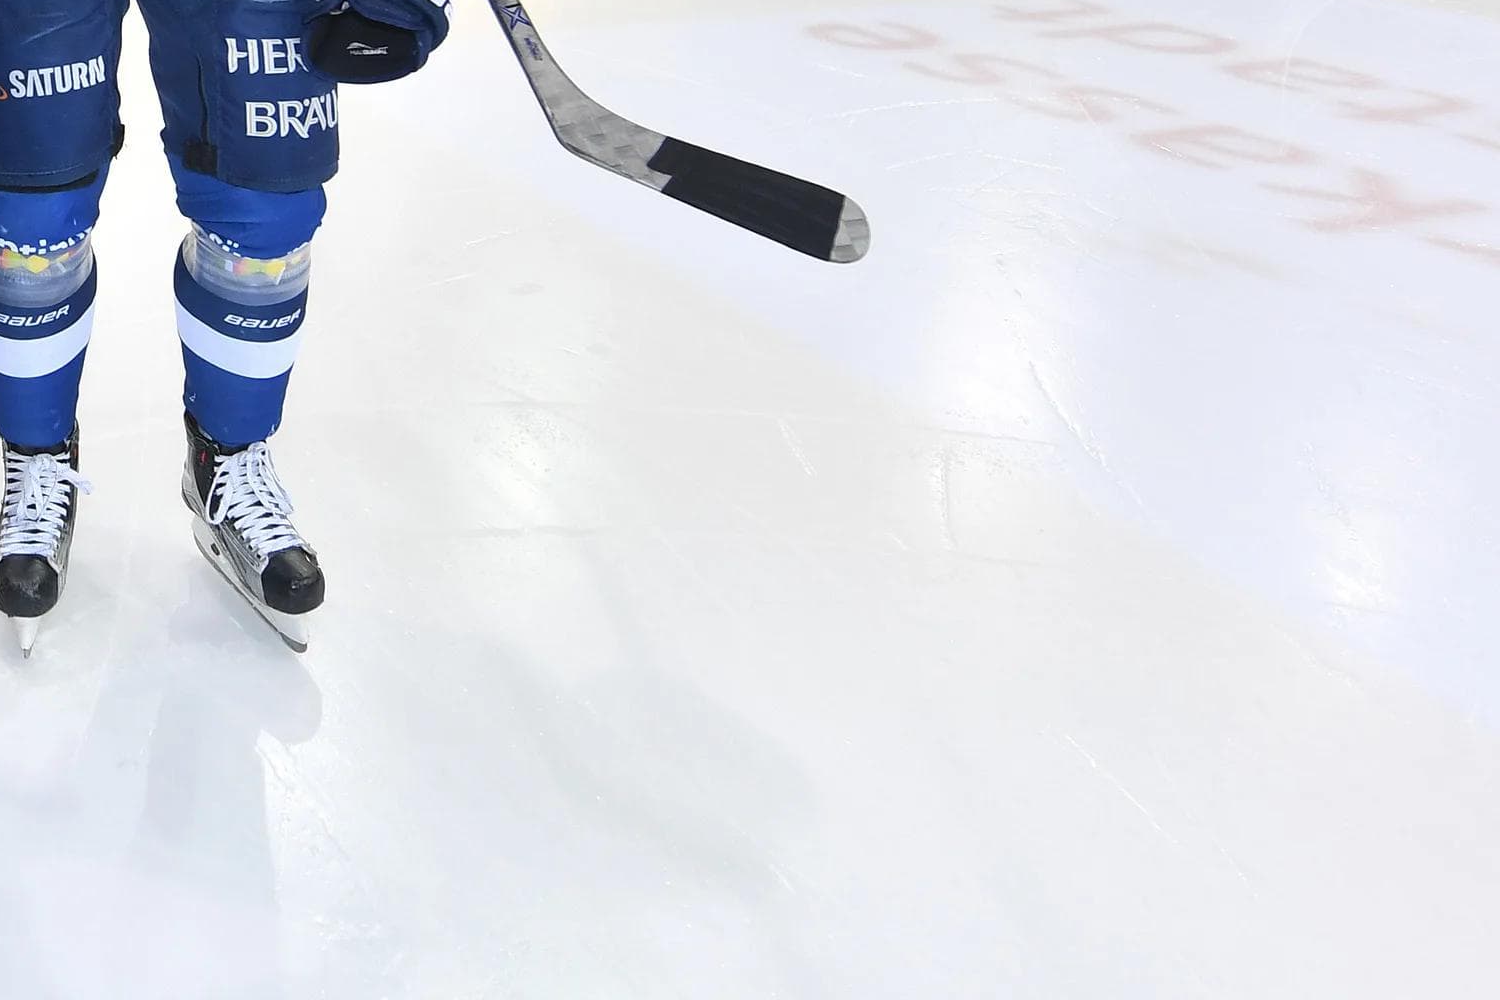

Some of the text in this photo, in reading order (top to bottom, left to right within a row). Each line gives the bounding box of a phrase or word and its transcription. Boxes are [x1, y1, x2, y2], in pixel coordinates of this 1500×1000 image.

[10, 55, 106, 99] SATURN
[225, 36, 308, 76] HER
[245, 95, 338, 139] BRÄU
[223, 308, 301, 330] BAUER
